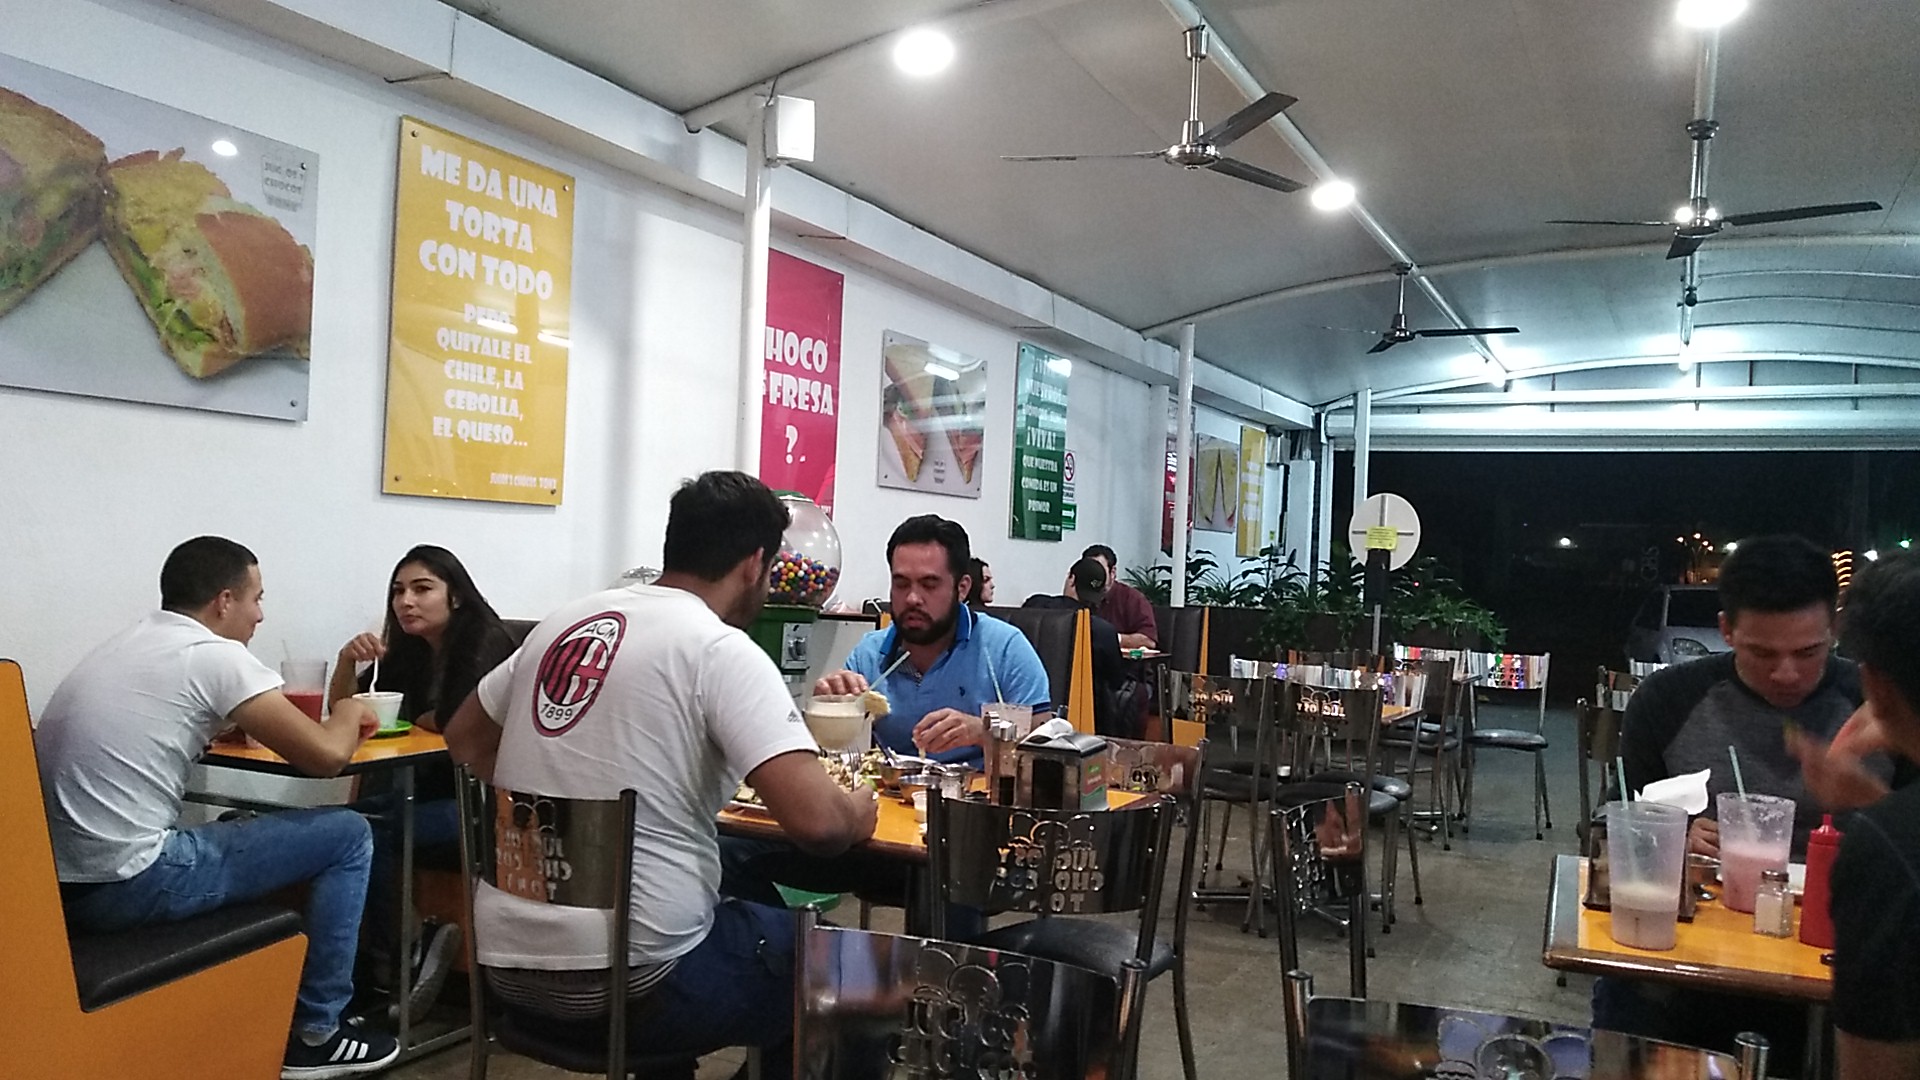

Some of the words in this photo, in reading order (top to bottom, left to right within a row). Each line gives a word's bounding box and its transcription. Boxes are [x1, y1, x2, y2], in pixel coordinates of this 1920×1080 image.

[421, 144, 461, 185] ME
[467, 160, 503, 200] DA
[509, 175, 557, 218] UNA
[446, 199, 533, 253] TORTA
[419, 239, 476, 279] CON
[482, 254, 553, 300] TODO
[436, 327, 510, 361] QUITALE
[514, 343, 532, 364] EL
[766, 326, 828, 373] HOCO
[444, 359, 500, 390] CHILE,
[504, 369, 523, 390] LA
[769, 370, 834, 416] FRESA
[444, 388, 523, 421] CEBOLLA,
[433, 416, 453, 438] EL
[541, 703, 573, 720] 1899
